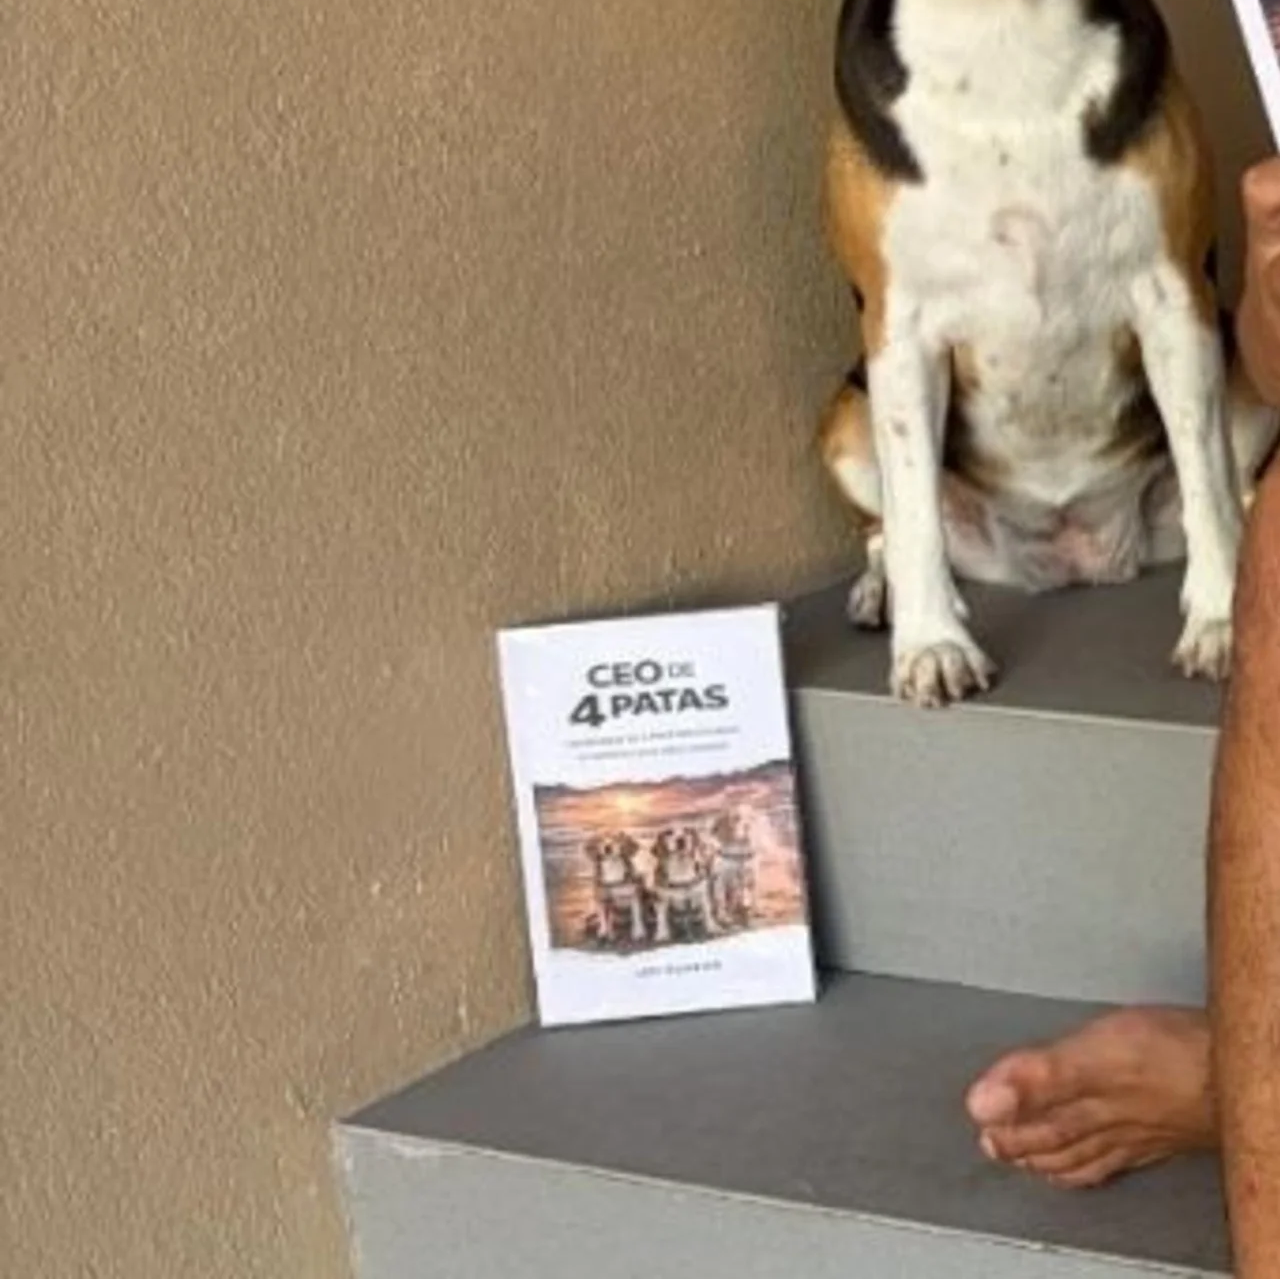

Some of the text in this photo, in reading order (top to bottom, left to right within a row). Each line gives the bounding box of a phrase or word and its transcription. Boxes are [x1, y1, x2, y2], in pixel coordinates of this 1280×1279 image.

[587, 659, 696, 689] CEO DE
[569, 684, 730, 728] 4 PATAS
